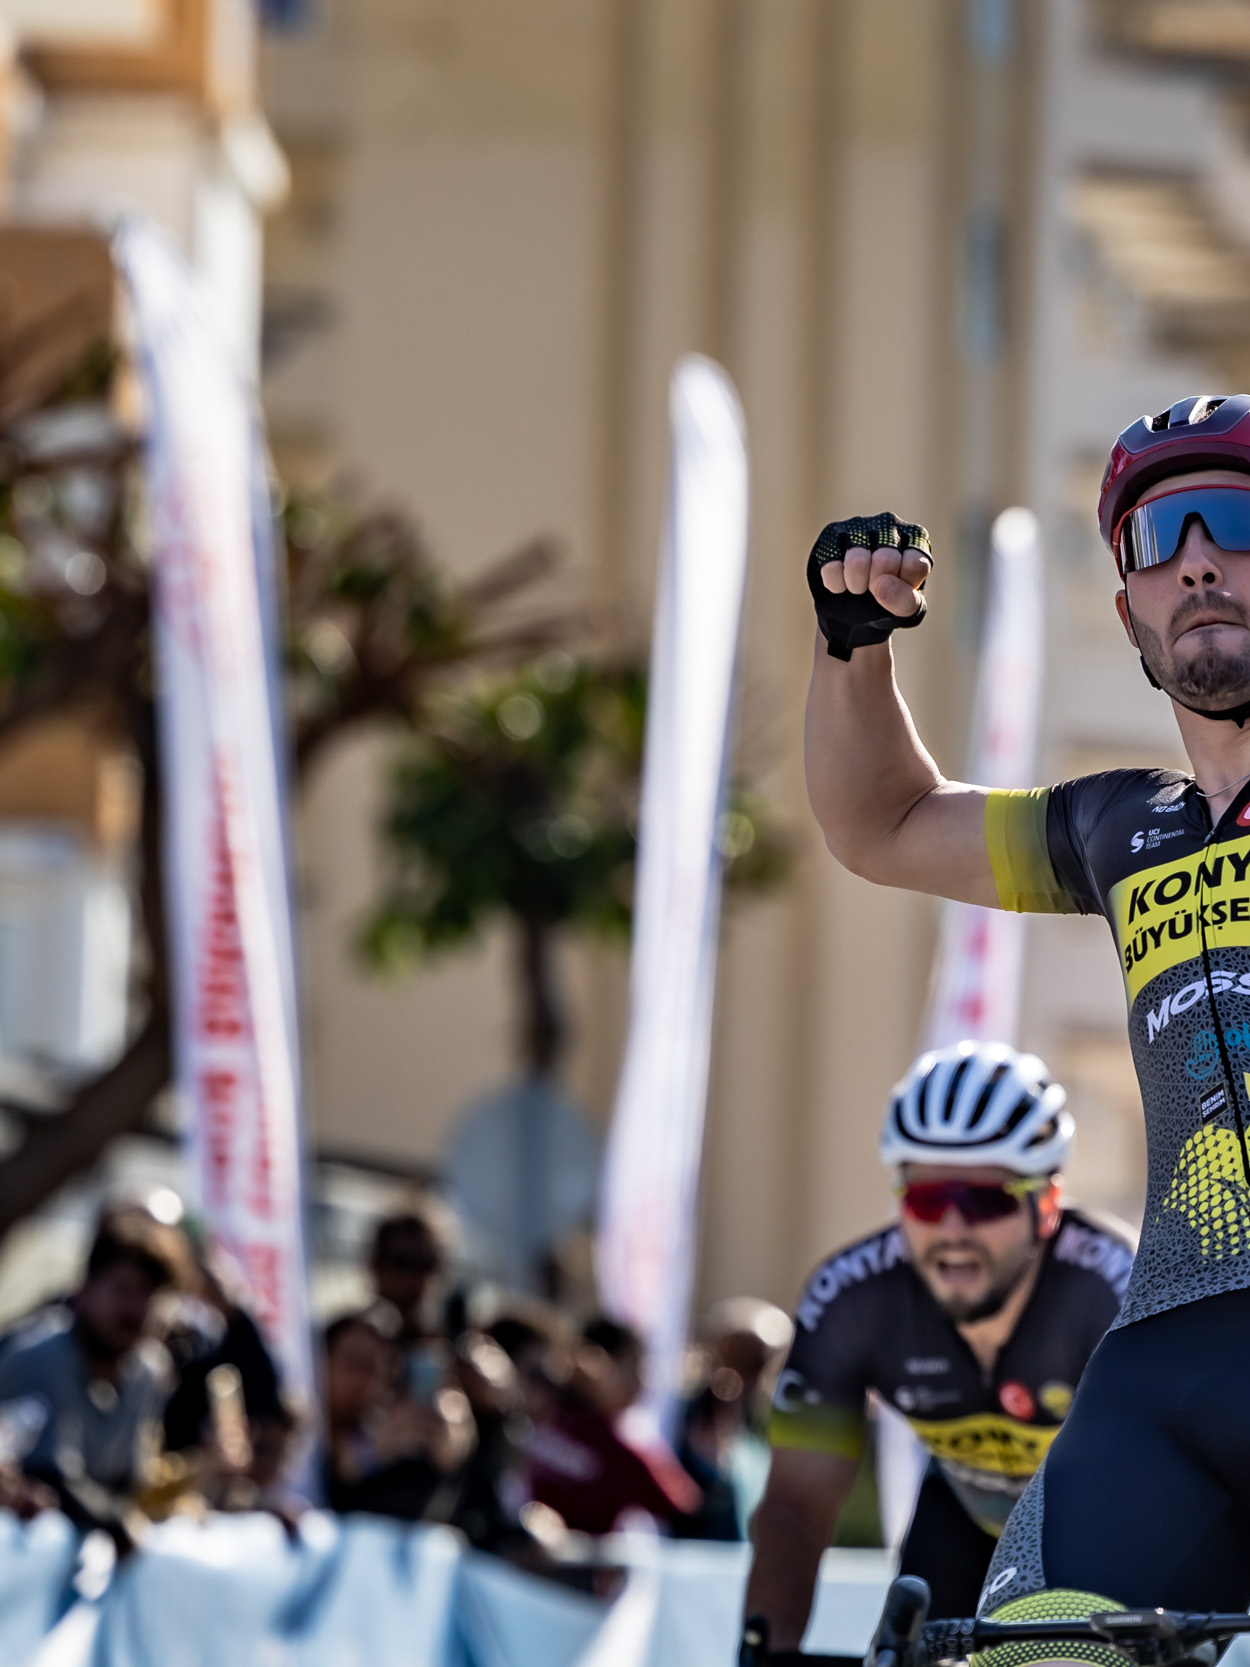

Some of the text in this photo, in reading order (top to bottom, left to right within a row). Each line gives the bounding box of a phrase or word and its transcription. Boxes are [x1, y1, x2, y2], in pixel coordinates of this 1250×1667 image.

[1146, 829, 1185, 843] CONTINENTAL
[1148, 828, 1161, 836] UCI
[1145, 841, 1161, 850] TEAM
